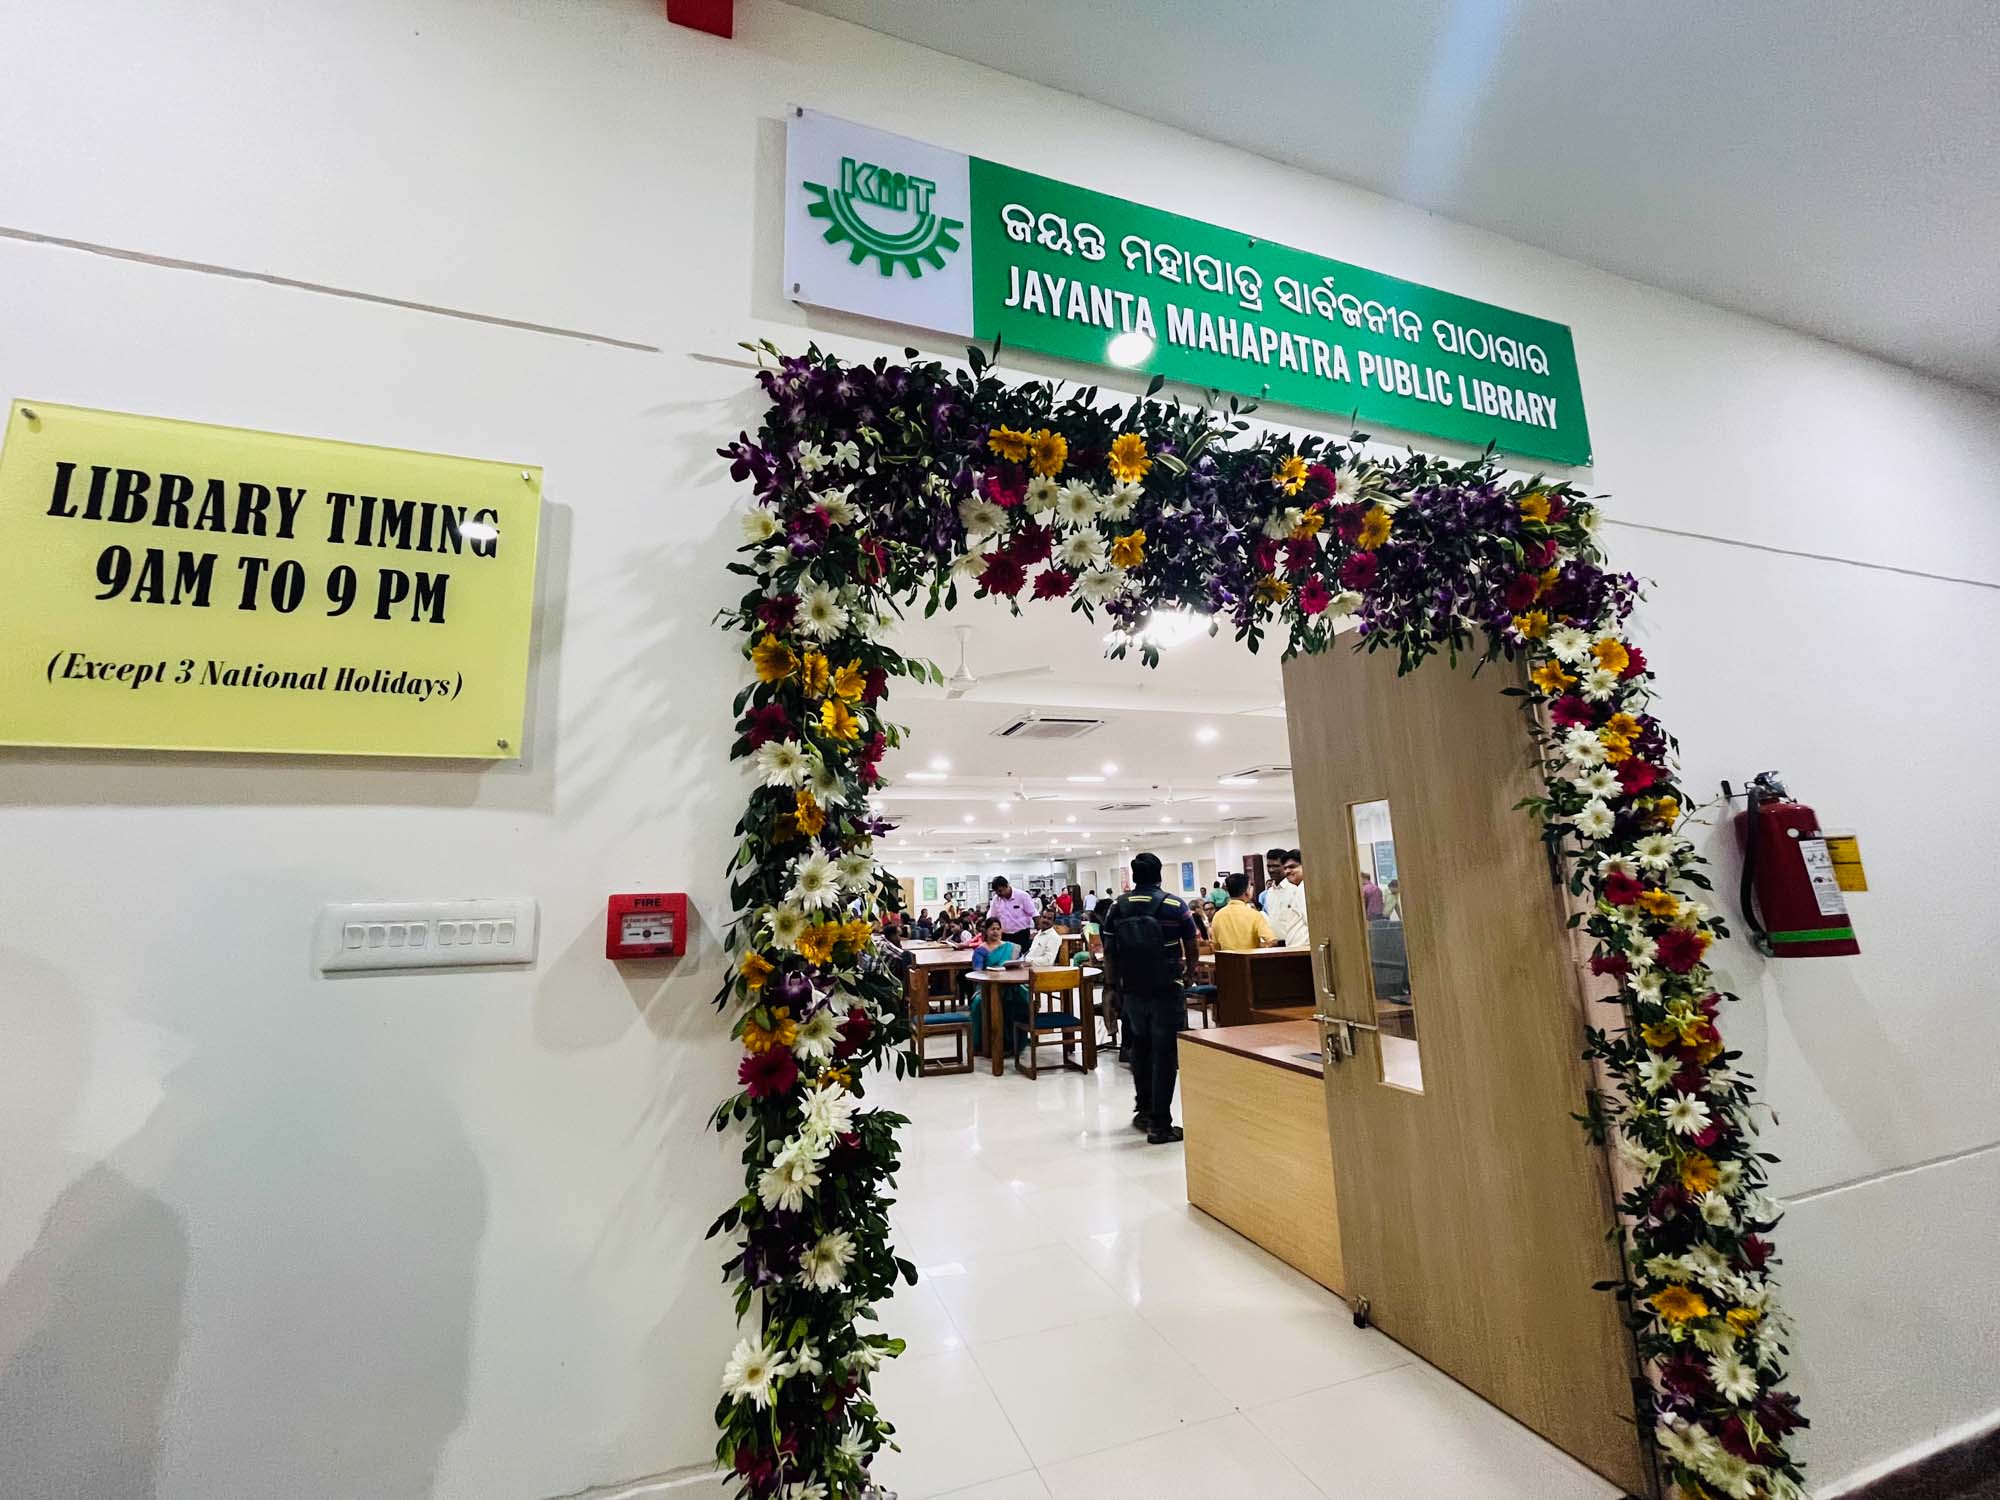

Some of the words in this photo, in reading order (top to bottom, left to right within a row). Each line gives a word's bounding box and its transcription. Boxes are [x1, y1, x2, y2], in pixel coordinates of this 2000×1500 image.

[1001, 203, 1106, 261] ଜୟନ୍ତ
[1121, 235, 1263, 312] ମହାପାତ୍ର
[1273, 275, 1423, 343] ସାର୍ବଜନୀନ
[1432, 319, 1550, 376] ପାଠାଗାର
[1005, 266, 1157, 339] JAYANTA
[1167, 303, 1352, 383] MAHAPATRA
[1358, 350, 1454, 407] PUBLIC
[1458, 374, 1558, 430] LIBRARY
[47, 461, 307, 540] LIBRARY
[326, 492, 501, 559] TIMING
[95, 544, 218, 608] 9AM
[238, 556, 306, 614] TO
[326, 565, 358, 617] 9
[374, 568, 450, 624] PM
[47, 651, 166, 690] (Except
[175, 658, 196, 685] 3
[200, 660, 328, 690] National
[334, 667, 464, 702] Holidays)
[634, 898, 662, 908] FIRE
